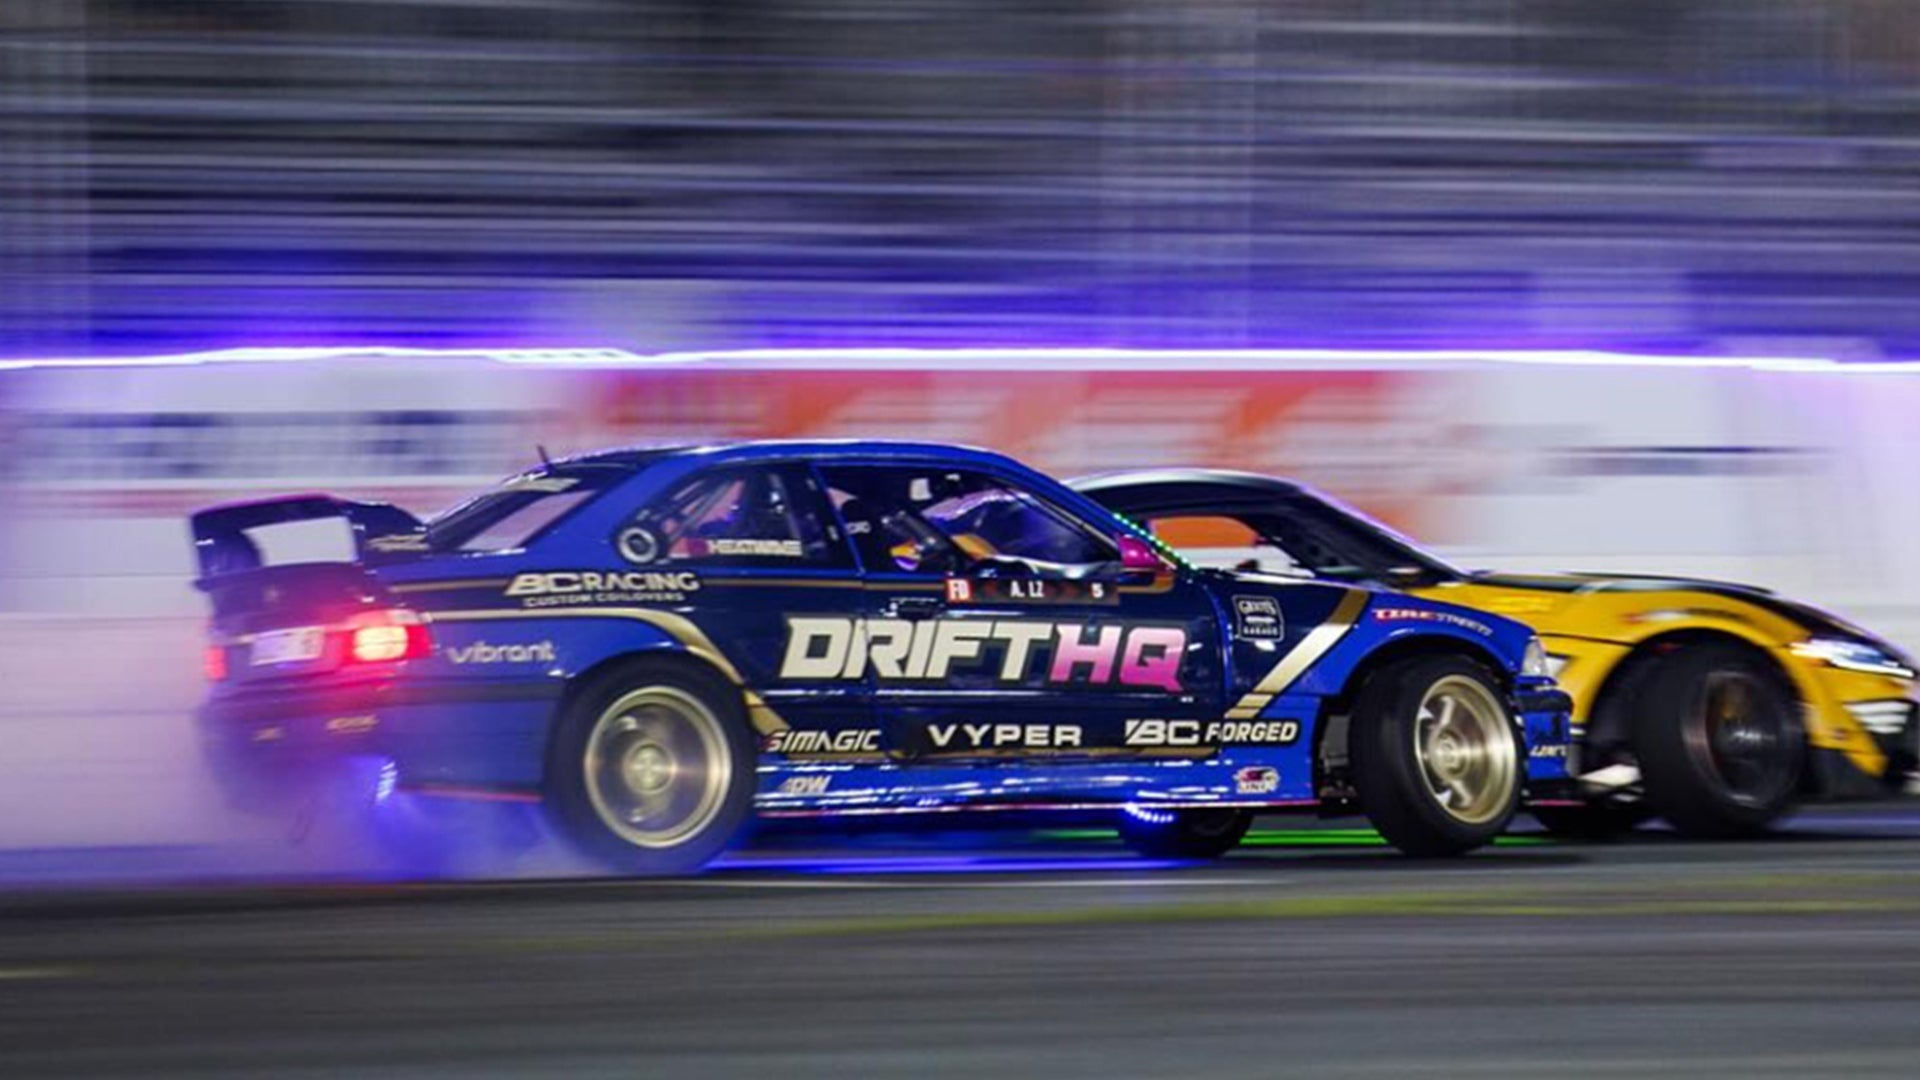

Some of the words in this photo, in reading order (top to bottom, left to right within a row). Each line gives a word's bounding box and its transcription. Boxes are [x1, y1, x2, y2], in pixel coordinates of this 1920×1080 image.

[447, 640, 556, 663] vibrant
[765, 730, 882, 753] SIMAGIC
[927, 724, 1082, 746] VYPER
[1204, 720, 1298, 743] FORGED
